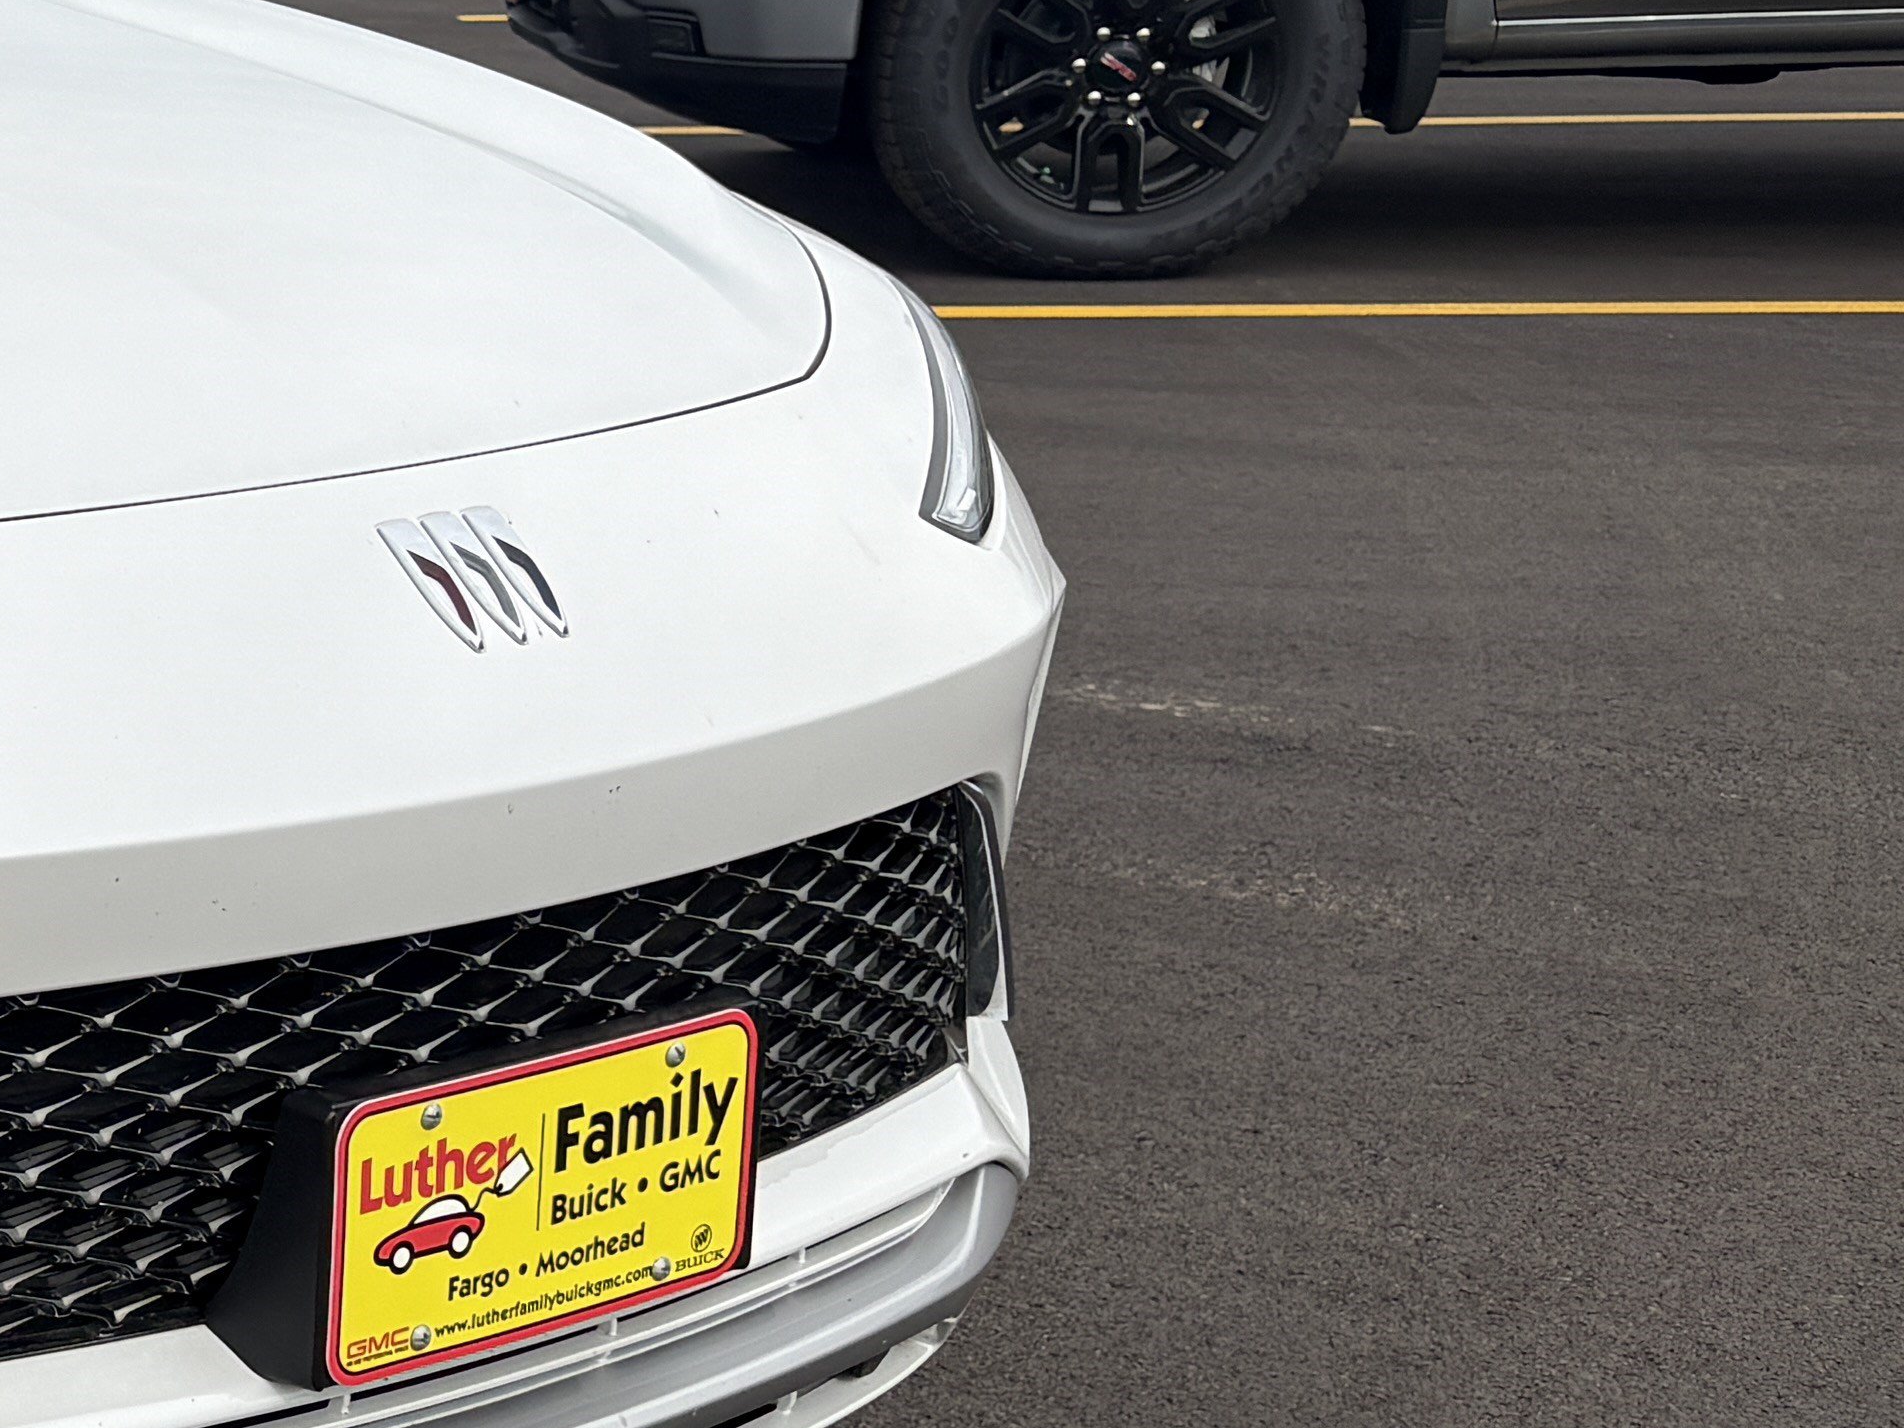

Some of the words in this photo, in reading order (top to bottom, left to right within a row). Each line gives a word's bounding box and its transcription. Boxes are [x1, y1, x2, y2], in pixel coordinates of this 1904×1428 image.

[553, 1068, 739, 1173] Family
[359, 1132, 518, 1215] Luther
[550, 1176, 628, 1225] Buick
[659, 1148, 723, 1192] GMC
[447, 1267, 510, 1302] Fargo
[535, 1221, 646, 1277] Moorhead
[674, 1248, 726, 1273] BUICK
[433, 1265, 653, 1338] www.lutherfamilybuickgmc.com
[346, 1326, 410, 1360] GMC
